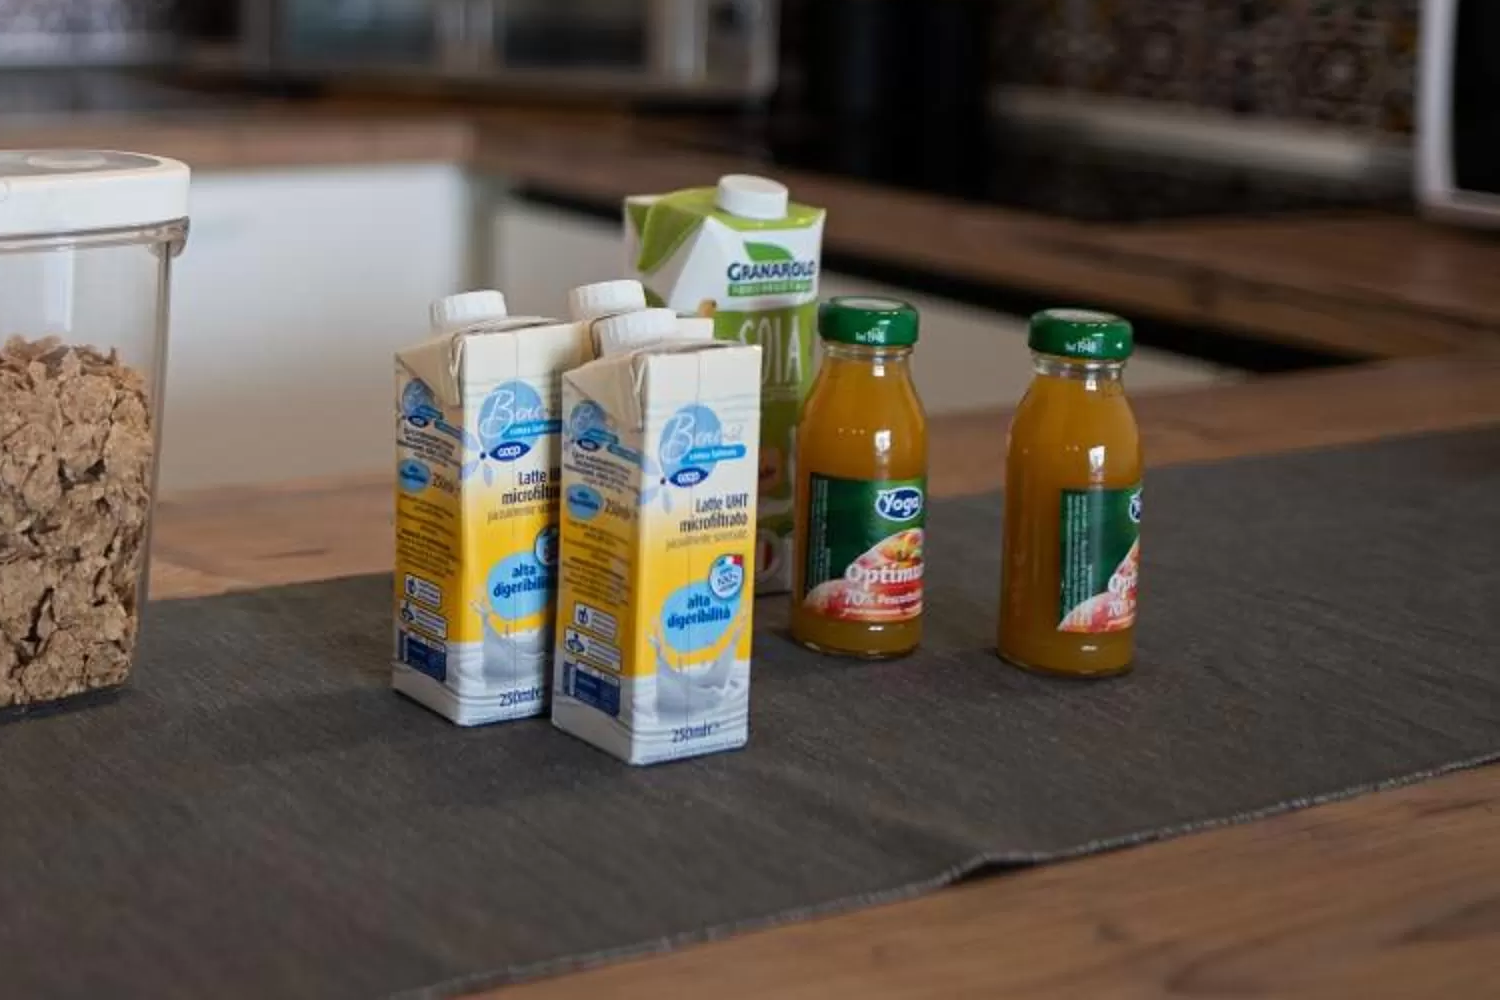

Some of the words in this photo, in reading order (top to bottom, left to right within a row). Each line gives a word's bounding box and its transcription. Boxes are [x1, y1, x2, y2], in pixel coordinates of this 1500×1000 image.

[518, 469, 547, 485] Latte
[695, 496, 723, 513] Latte
[511, 563, 536, 579] alta
[687, 593, 711, 609] alta
